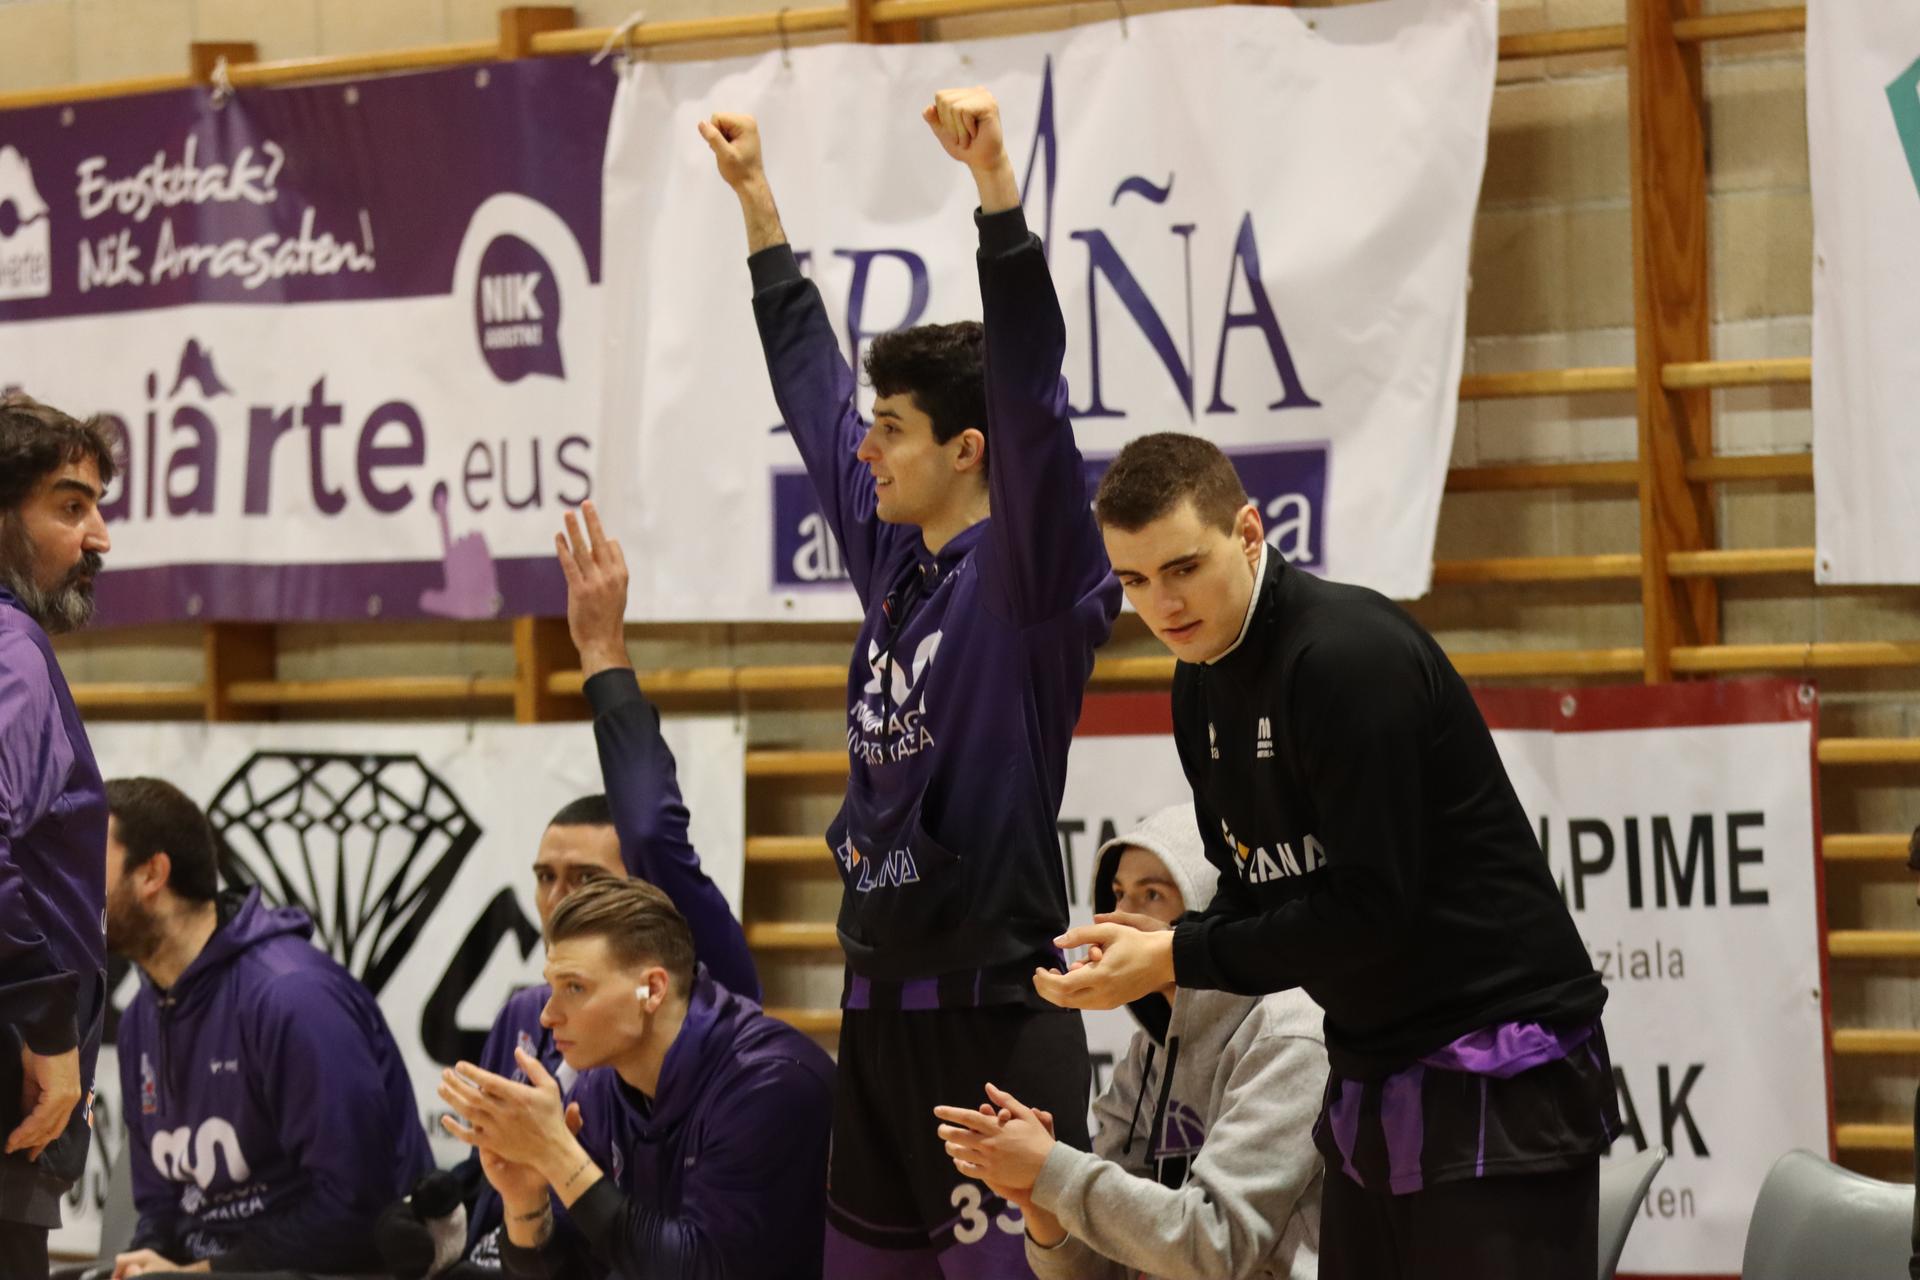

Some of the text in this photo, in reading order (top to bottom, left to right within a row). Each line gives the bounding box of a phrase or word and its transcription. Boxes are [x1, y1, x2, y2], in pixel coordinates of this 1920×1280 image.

[79, 228, 143, 293] Nik
[151, 206, 376, 289] Arrasaten!
[481, 271, 544, 324] NIK
[1540, 810, 1770, 912] PIME
